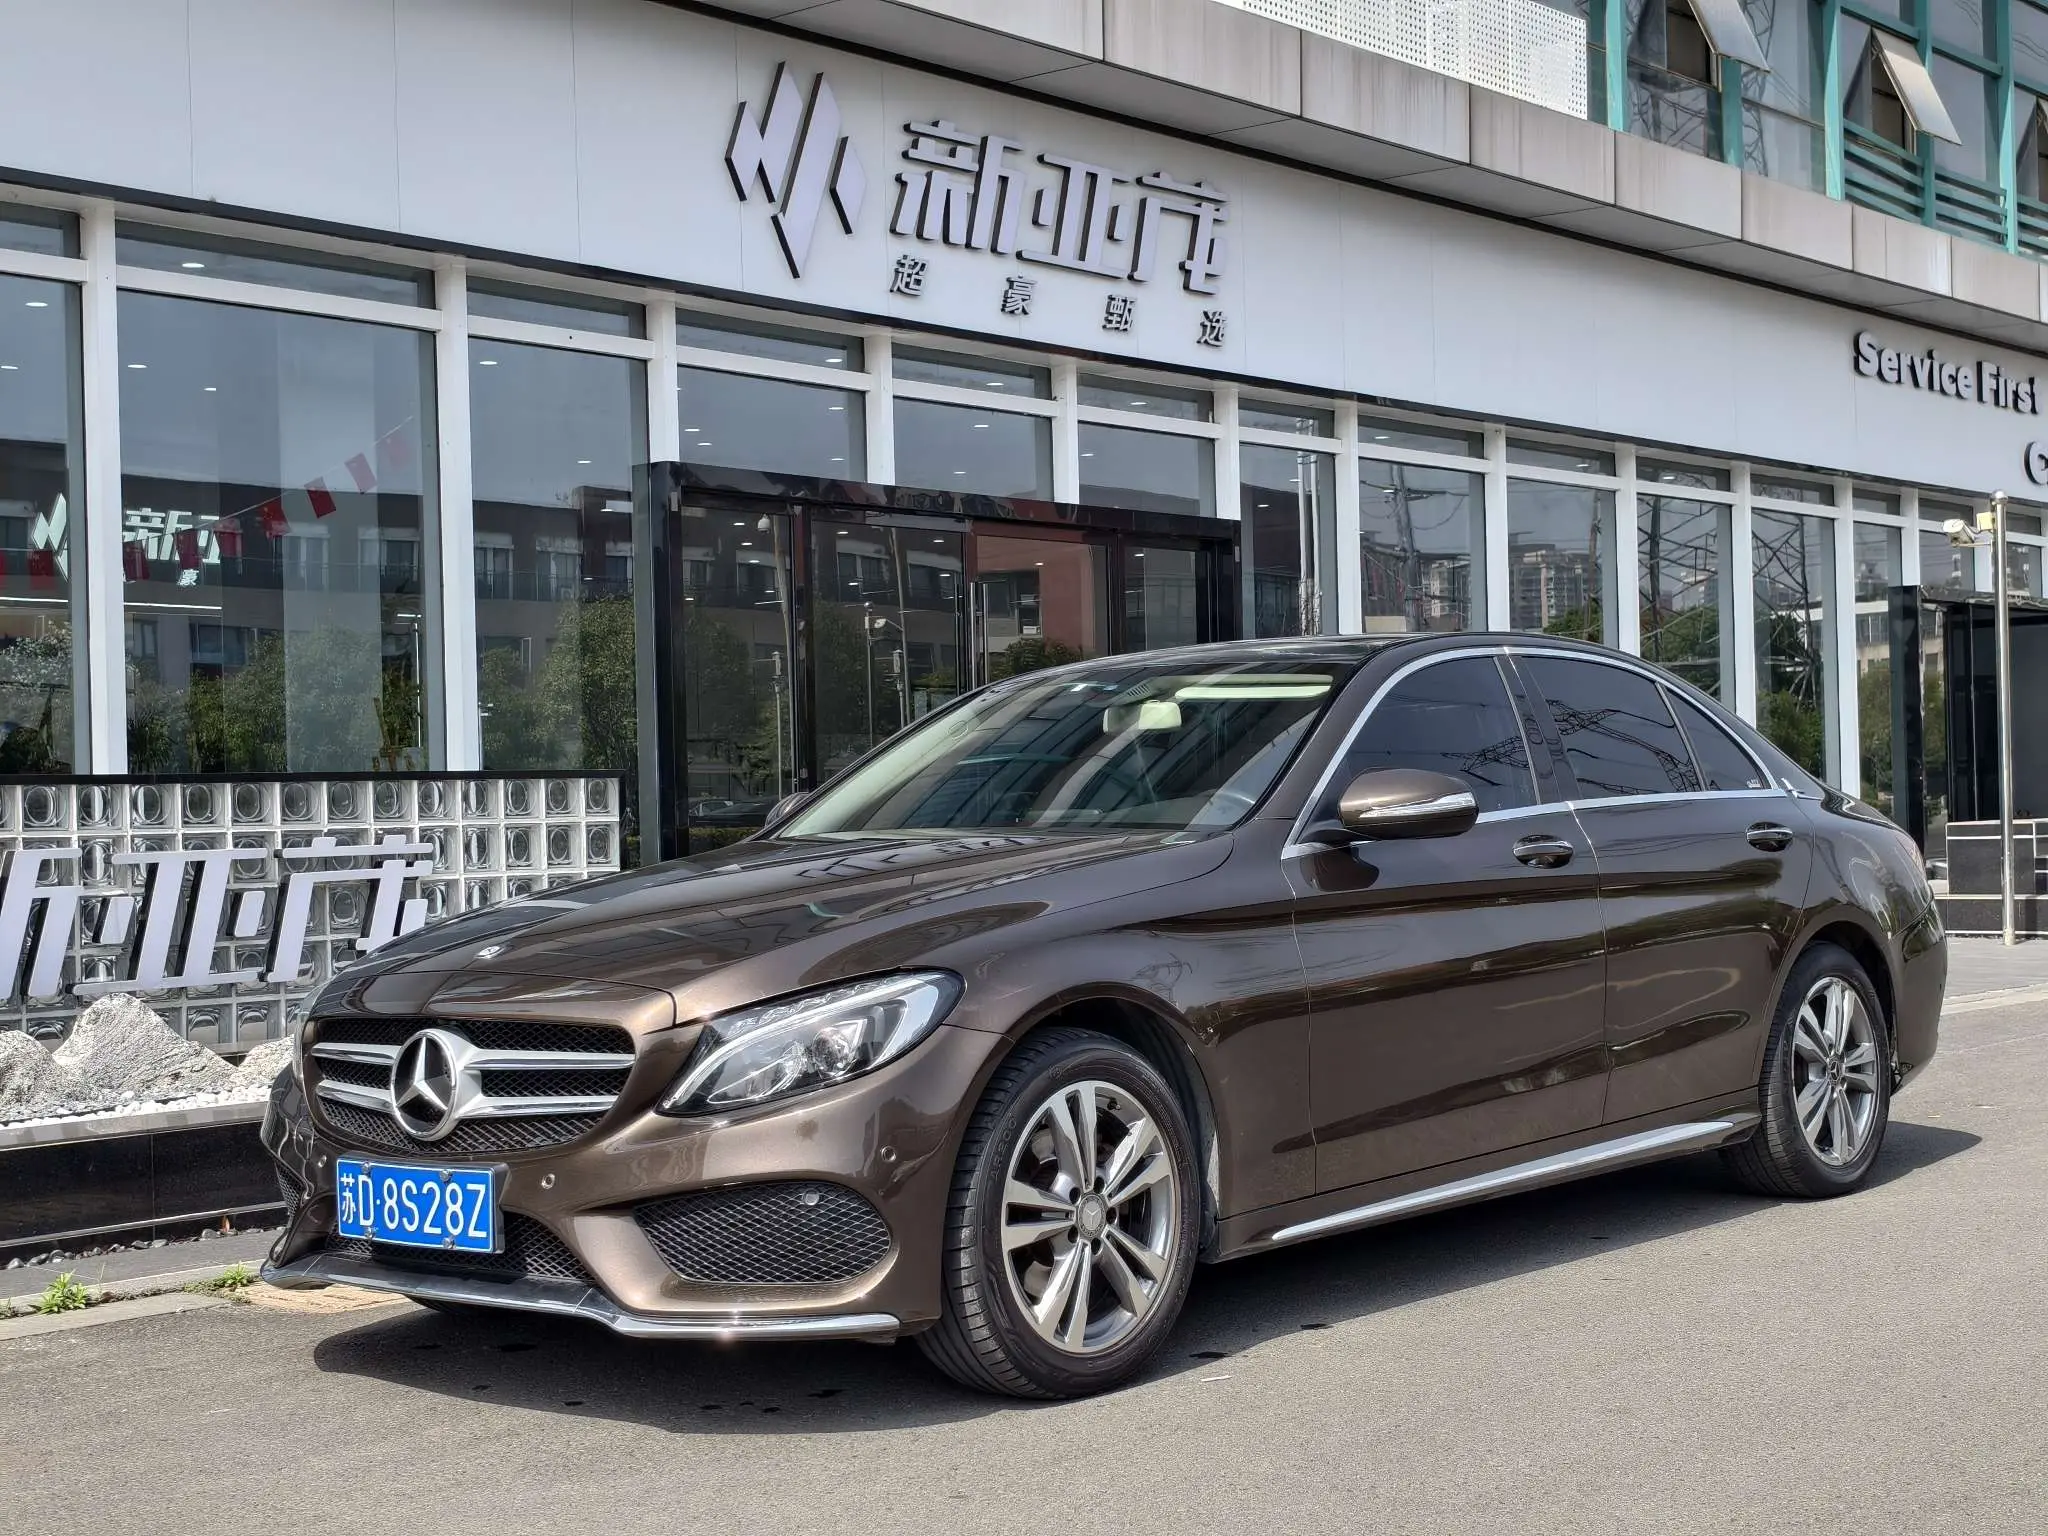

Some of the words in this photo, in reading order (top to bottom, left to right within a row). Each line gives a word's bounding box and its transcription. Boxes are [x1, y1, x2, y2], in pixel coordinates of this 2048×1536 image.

[889, 253, 1227, 349] 超豪甄选
[1854, 330, 1973, 400] Service
[1976, 360, 2042, 414] First
